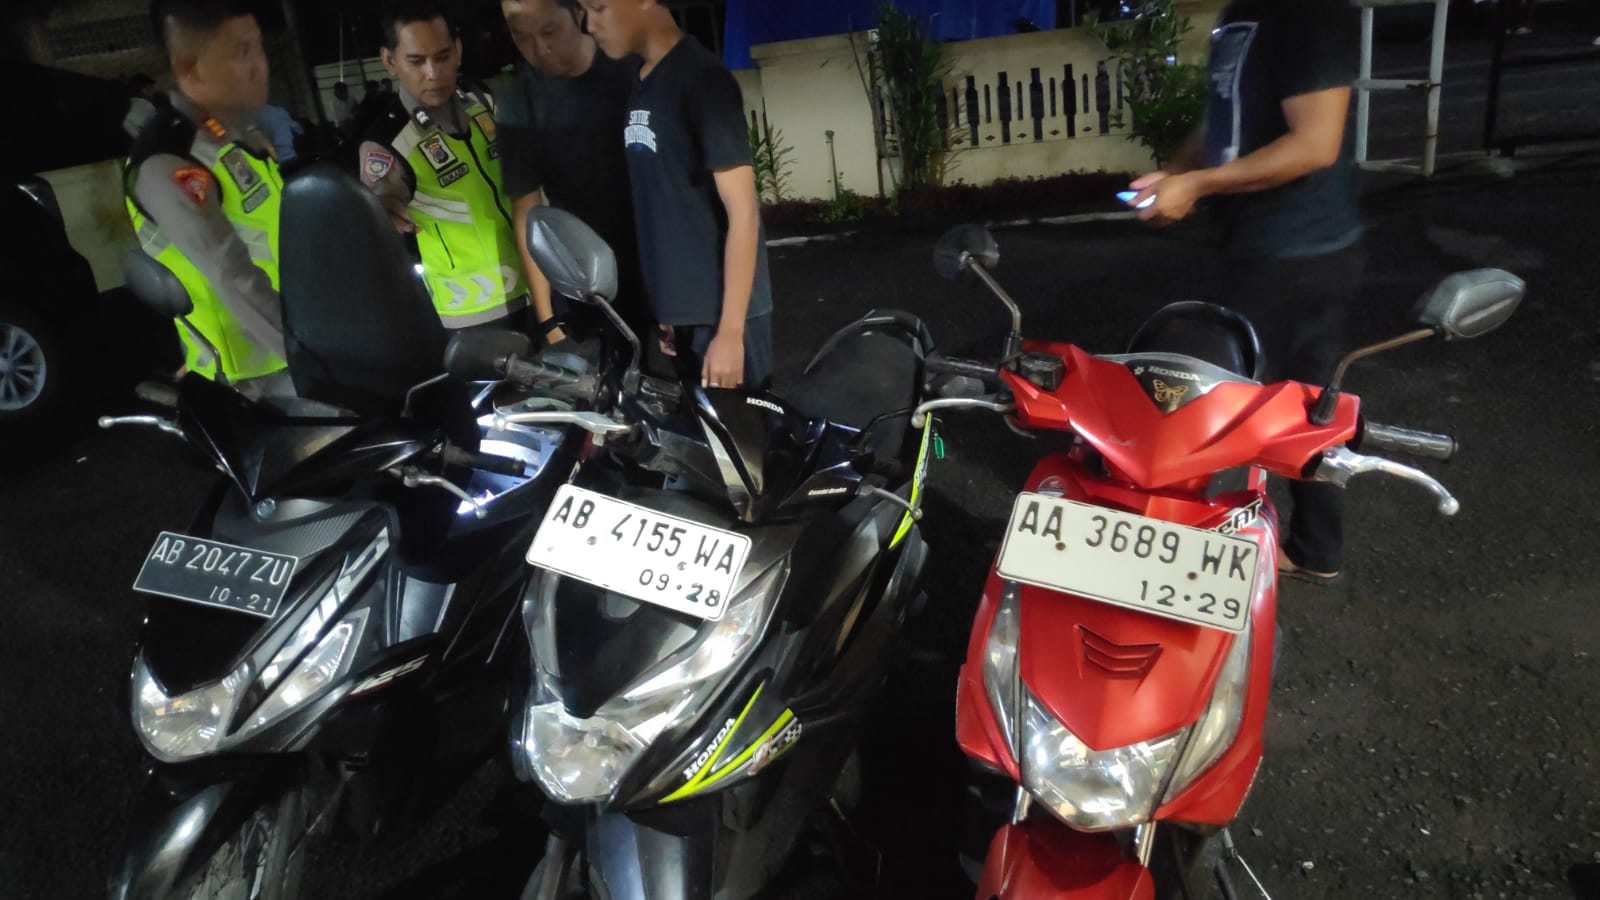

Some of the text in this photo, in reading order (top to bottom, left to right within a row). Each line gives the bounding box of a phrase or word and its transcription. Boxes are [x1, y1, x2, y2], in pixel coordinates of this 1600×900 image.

[1148, 365, 1201, 381] HONDA
[746, 396, 784, 414] HONDA
[151, 537, 289, 586] AB 2047 ZU
[552, 495, 735, 575] AB 4155 WA
[1018, 501, 1251, 581] AA 3689 WK
[683, 718, 736, 780] HONDA
